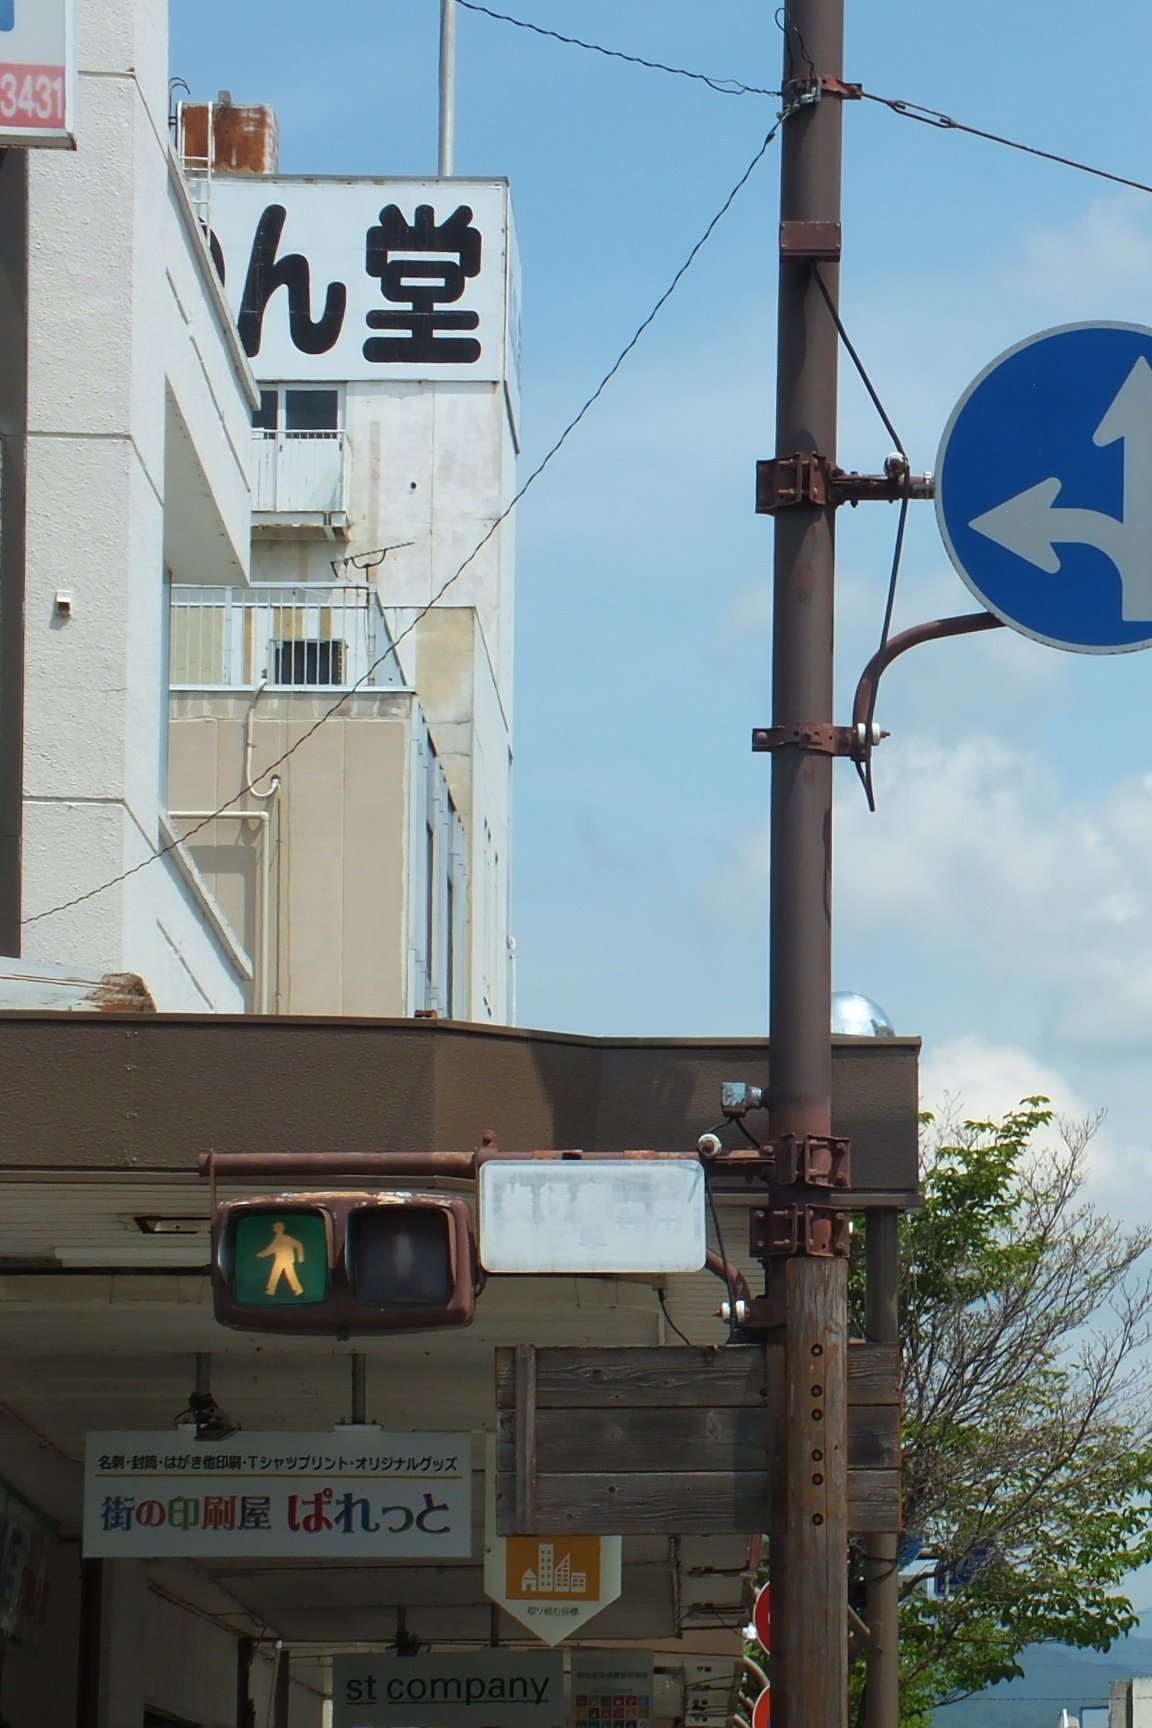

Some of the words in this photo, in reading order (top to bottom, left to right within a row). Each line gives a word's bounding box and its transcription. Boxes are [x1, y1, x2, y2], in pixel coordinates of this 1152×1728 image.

[0, 72, 64, 119] 3431
[200, 203, 482, 364] ん堂
[100, 1495, 272, 1532] 街の印刷屋
[287, 1487, 452, 1535] ぱれっと
[346, 1674, 377, 1701] st
[387, 1676, 551, 1705] company
